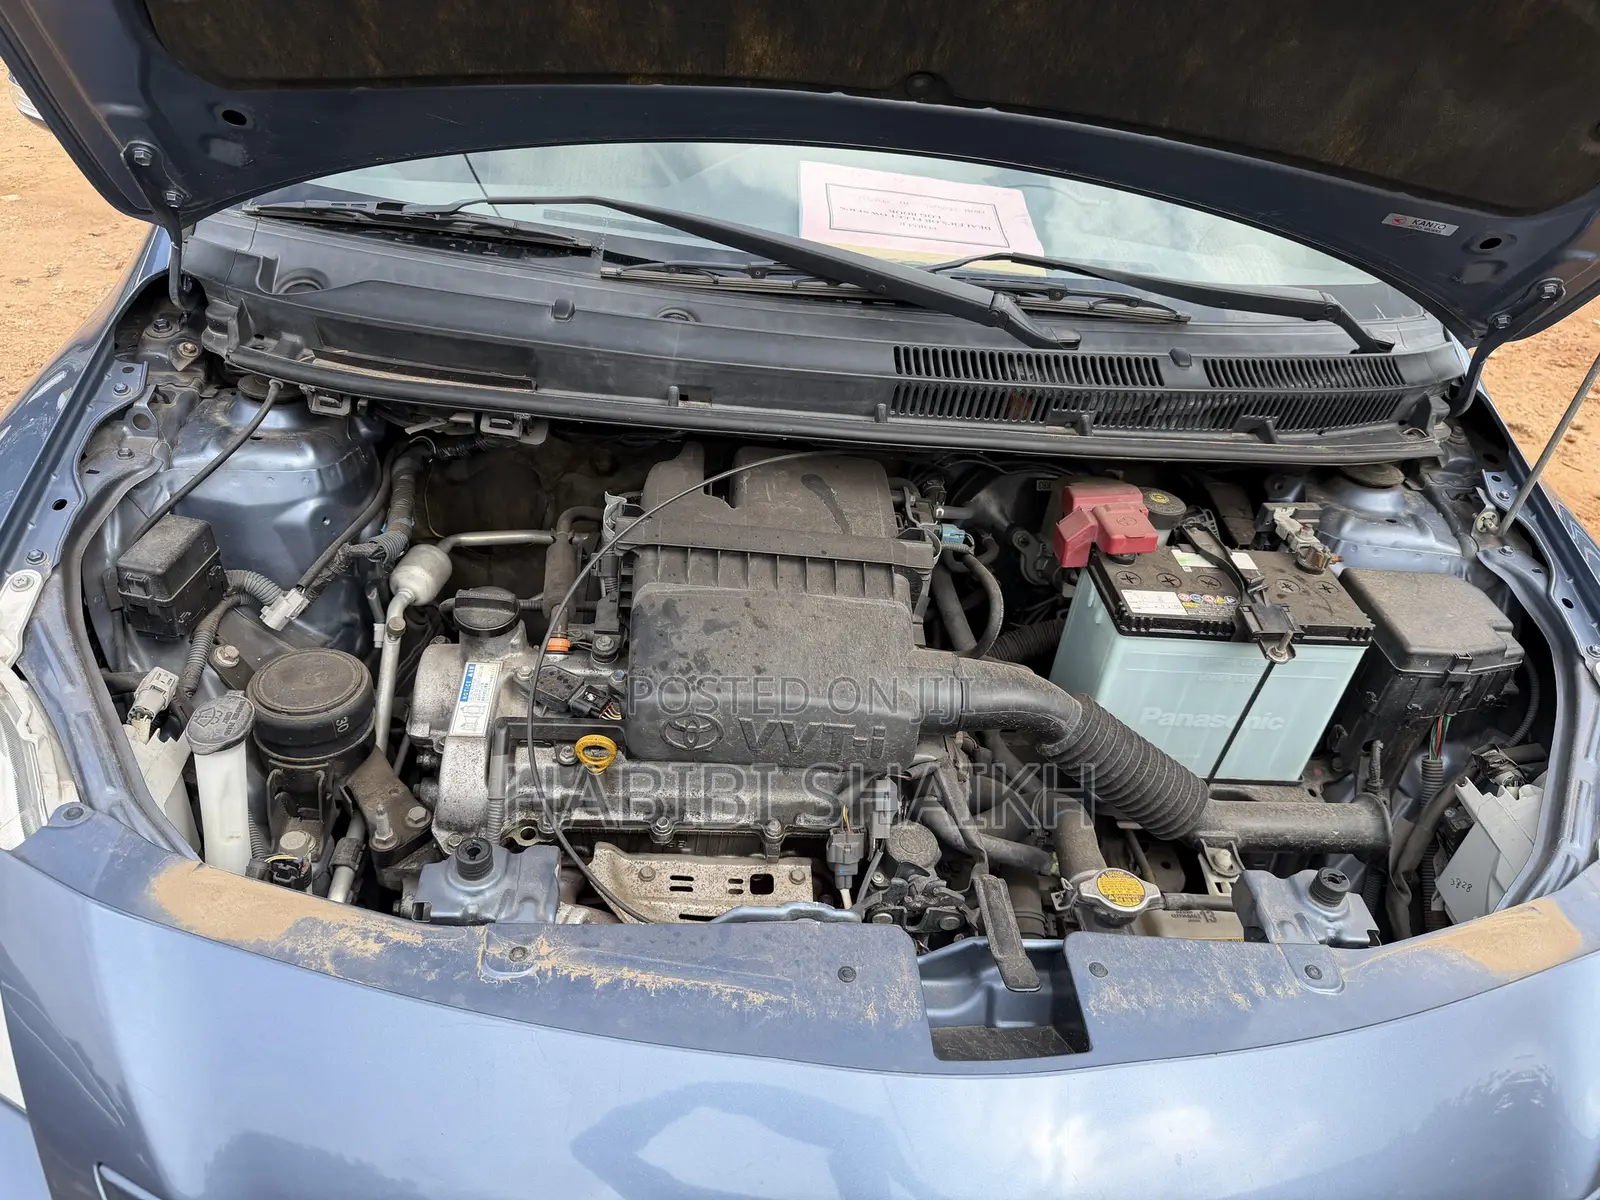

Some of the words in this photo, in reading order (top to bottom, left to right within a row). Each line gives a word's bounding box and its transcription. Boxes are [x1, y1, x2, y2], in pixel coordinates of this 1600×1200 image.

[887, 208, 917, 217] BOOK
[1411, 218, 1447, 230] KANTO
[738, 717, 886, 759] VVT-i
